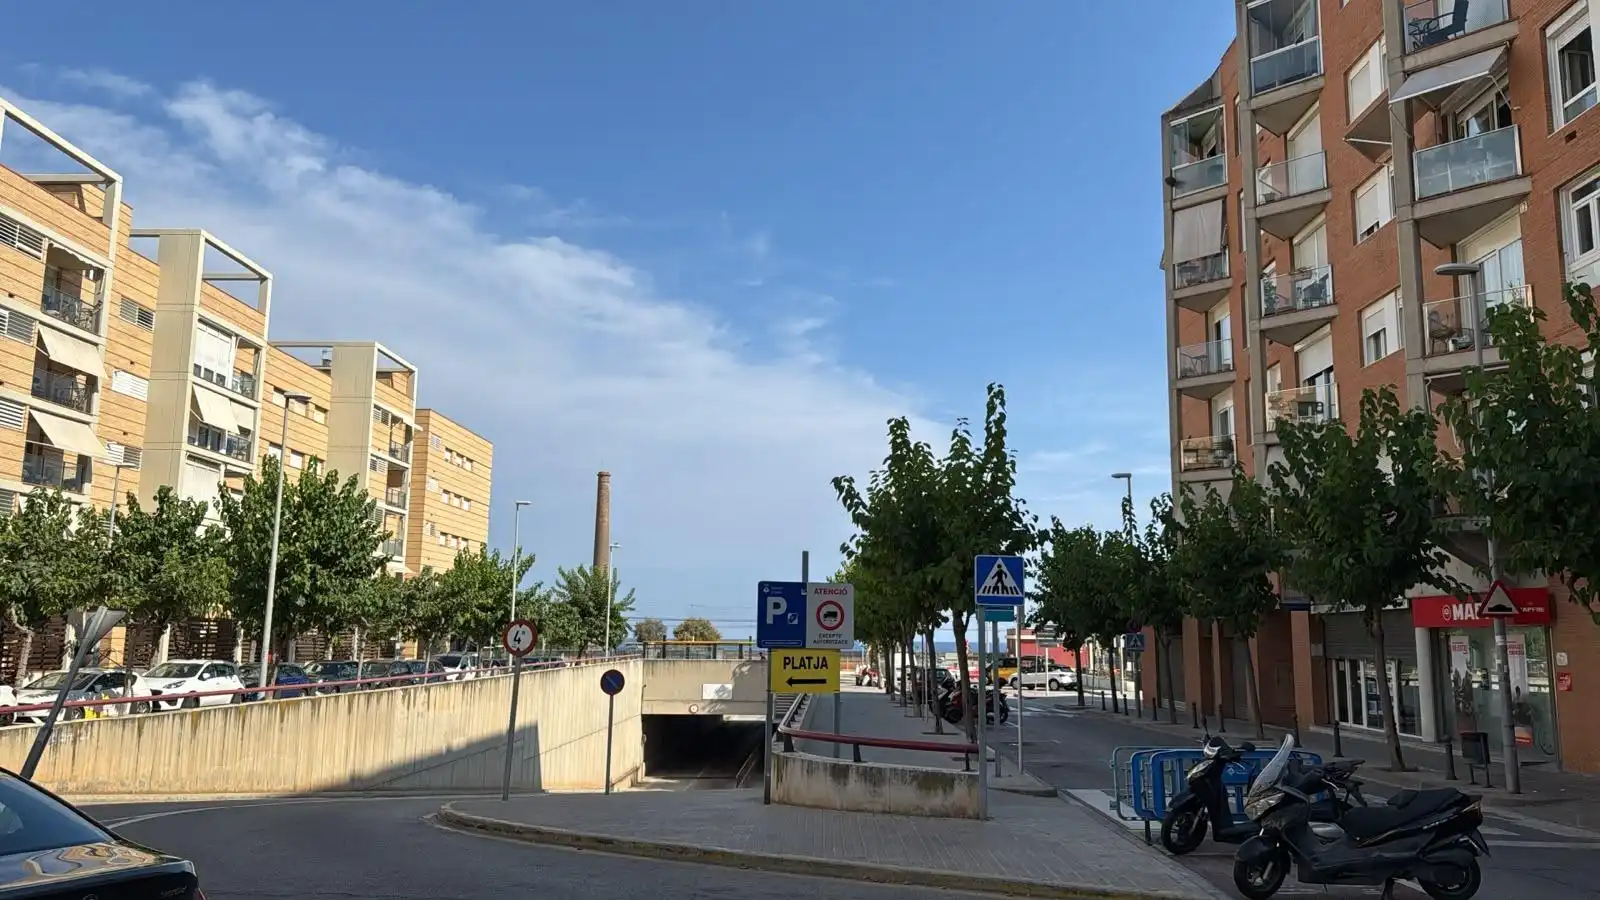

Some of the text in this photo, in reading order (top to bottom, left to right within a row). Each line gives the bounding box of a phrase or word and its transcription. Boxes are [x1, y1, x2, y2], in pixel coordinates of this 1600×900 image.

[814, 587, 848, 596] ATENCIÓ
[766, 596, 787, 625] P
[783, 656, 829, 670] PLATJA
